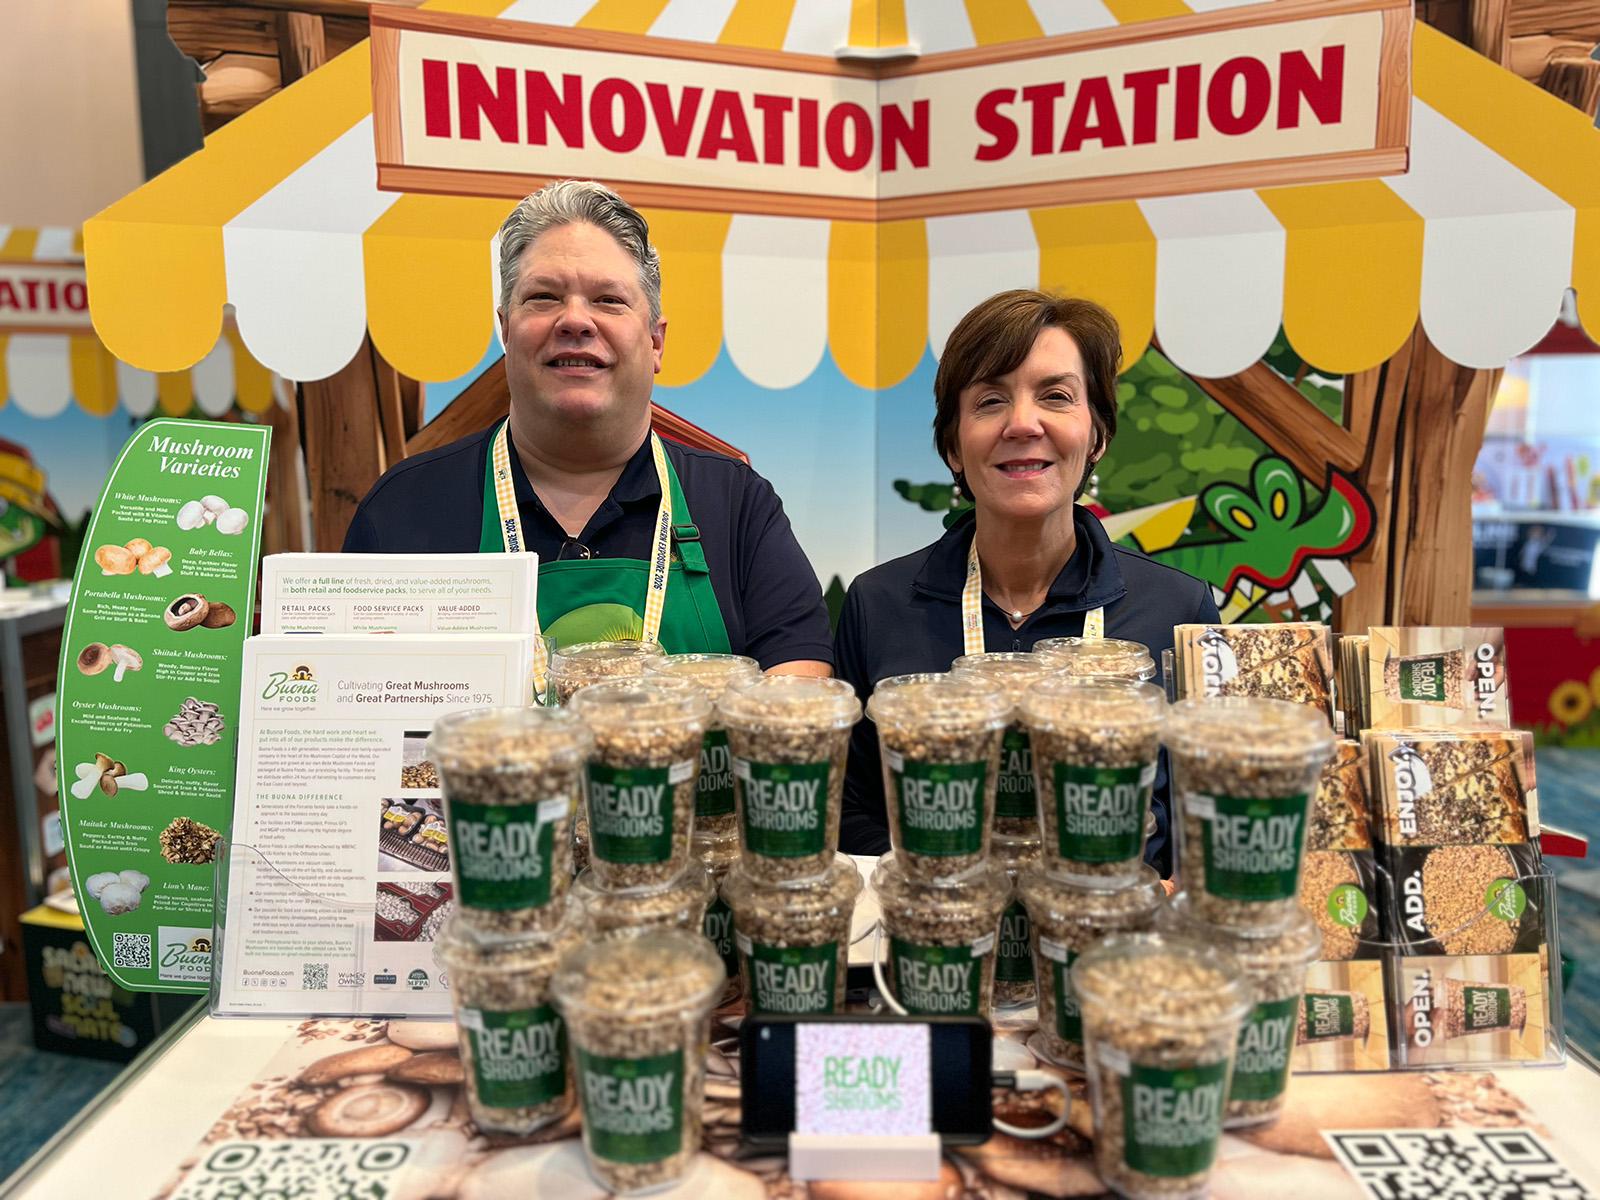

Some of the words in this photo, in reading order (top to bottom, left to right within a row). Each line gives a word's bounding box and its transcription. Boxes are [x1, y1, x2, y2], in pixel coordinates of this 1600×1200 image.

[422, 59, 929, 172] INNOVATION
[975, 45, 1345, 161] STATION
[0, 281, 87, 311] ATIO
[148, 436, 254, 460] Mushroom
[160, 456, 241, 478] Varieties
[114, 493, 135, 501] White
[137, 494, 182, 504] Mushrooms:
[188, 548, 207, 557] Baby
[208, 549, 232, 558] Bellas:
[656, 540, 666, 573] EXPOSURE
[84, 590, 120, 599] Portabella
[123, 593, 166, 602] Mushrooms:
[384, 587, 407, 596] packs,
[152, 649, 181, 657] Shiitake
[184, 651, 227, 661] Mushrooms:
[262, 672, 319, 700] Buona
[337, 681, 383, 692] Cultivating
[385, 681, 411, 690] Great
[413, 681, 469, 690] Mushrooms
[1412, 663, 1422, 696] SHROOMS
[1420, 662, 1437, 697] READY
[1477, 643, 1496, 717] OPEN.
[72, 701, 95, 710] Oyster
[98, 703, 141, 712] Mushrooms:
[336, 694, 352, 703] and
[355, 694, 382, 703] Great
[384, 694, 443, 705] Partnerships
[446, 694, 469, 703] Since
[472, 694, 494, 703] 1975.
[168, 766, 185, 775] King
[187, 767, 215, 776] Oysters:
[700, 744, 732, 774] ADY
[591, 783, 666, 818] READY
[746, 778, 820, 811] READY
[902, 776, 980, 808] READY
[1064, 782, 1140, 817] READY
[1394, 754, 1417, 834] ENJOY.
[79, 820, 107, 828] Maitake
[110, 822, 153, 831] Mushrooms:
[596, 812, 664, 838] SHROOMS
[749, 808, 818, 832] SHROOMS
[906, 806, 976, 828] SHROOMS
[1066, 812, 1140, 836] SHROOMS
[1212, 812, 1301, 852] READY
[456, 820, 541, 859] READY
[460, 855, 543, 882] SHROOMS
[1212, 848, 1295, 872] SHROOMS
[1340, 889, 1356, 924] Buona
[1404, 870, 1425, 932] ADD.
[754, 960, 830, 994] READY
[899, 958, 975, 992] READY
[758, 990, 828, 1013] SHROOMS
[902, 990, 972, 1013] SHROOMS
[1313, 998, 1332, 1035] READY
[1412, 970, 1432, 1047] OPEN.
[1473, 991, 1489, 1026] READY
[1488, 991, 1498, 1024] SHROOMS
[476, 1017, 562, 1061] READY
[480, 1050, 561, 1083] SHROOMS
[824, 1056, 902, 1088] READY
[584, 1072, 675, 1113] READY
[1132, 1079, 1222, 1123] READY
[590, 1106, 674, 1135] SHROOMS
[1134, 1115, 1220, 1148] SHROOMS
